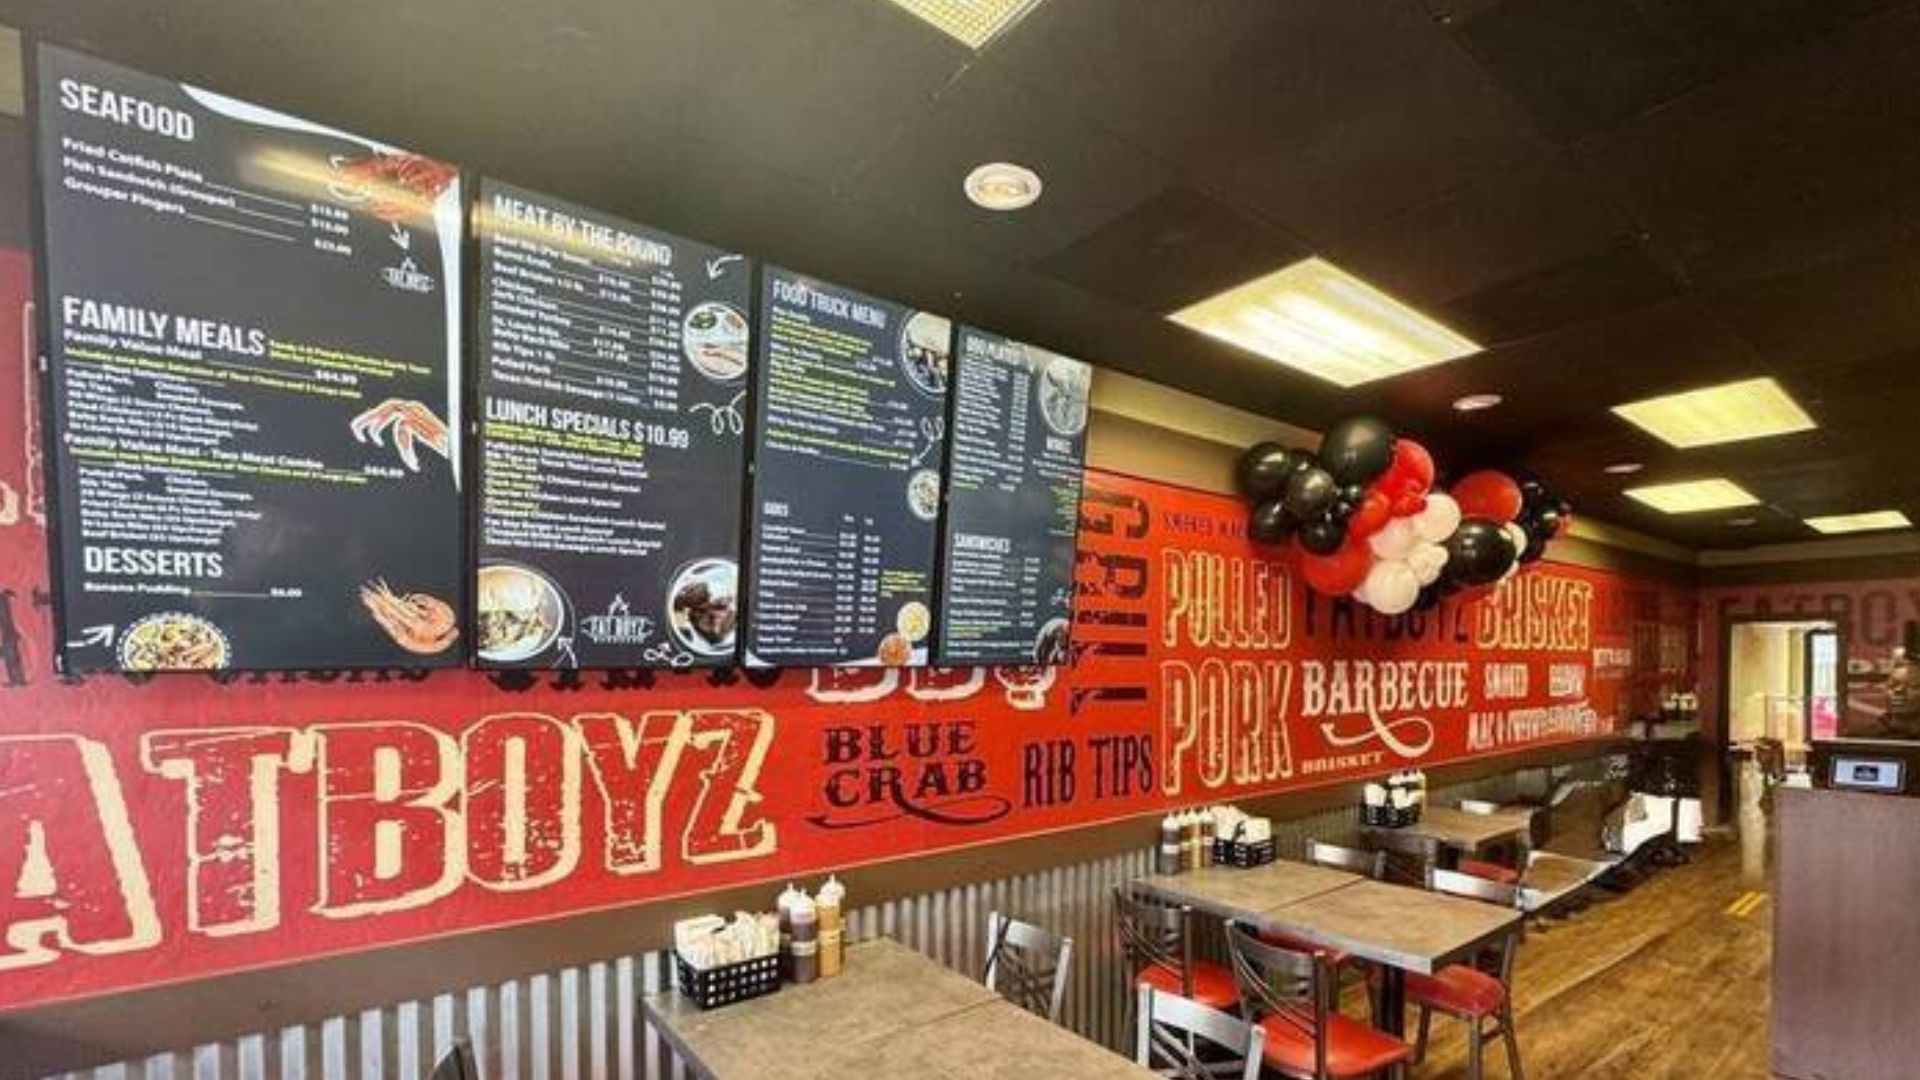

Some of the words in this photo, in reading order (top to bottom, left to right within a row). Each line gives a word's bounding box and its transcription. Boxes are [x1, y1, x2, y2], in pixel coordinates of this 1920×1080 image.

[59, 77, 194, 142] SEAFOOD
[61, 136, 104, 159] Fried
[107, 148, 161, 173] Catfish
[164, 162, 202, 183] Plate
[63, 155, 94, 174] Fish
[97, 164, 166, 191] Sandwich
[63, 175, 128, 203] Grouper
[132, 191, 185, 216] Fingers
[493, 193, 544, 230] MEAT
[551, 212, 574, 240] BY
[579, 220, 614, 251] THE
[63, 295, 169, 341] FAMILY
[175, 314, 265, 356] MEALS
[772, 277, 808, 306] FOOD
[811, 289, 850, 319] TRUCK
[851, 302, 886, 330] MENU
[64, 329, 117, 348] Family
[118, 337, 162, 355] Value
[165, 345, 202, 361] Meal
[486, 396, 549, 427] LUNCH
[551, 408, 630, 440] SPECIALS
[633, 422, 688, 450] $10.99
[63, 432, 117, 448] Family
[120, 438, 161, 453] Value
[166, 443, 199, 457] Meal
[212, 448, 238, 461] Two
[242, 451, 273, 464] Meat
[279, 455, 323, 470] Combo
[84, 545, 223, 578] DESSERTS
[83, 582, 133, 593] Banana
[137, 584, 191, 595] Pudding
[1070, 494, 1149, 718] GRILL
[1161, 548, 1291, 648] PULLED
[1475, 571, 1594, 651] BRISKET
[823, 720, 977, 763] BLUE
[1160, 658, 1294, 797] PORK
[1023, 741, 1077, 808] RIB
[1088, 734, 1154, 800] TIPS
[1302, 751, 1384, 774] BRISKET
